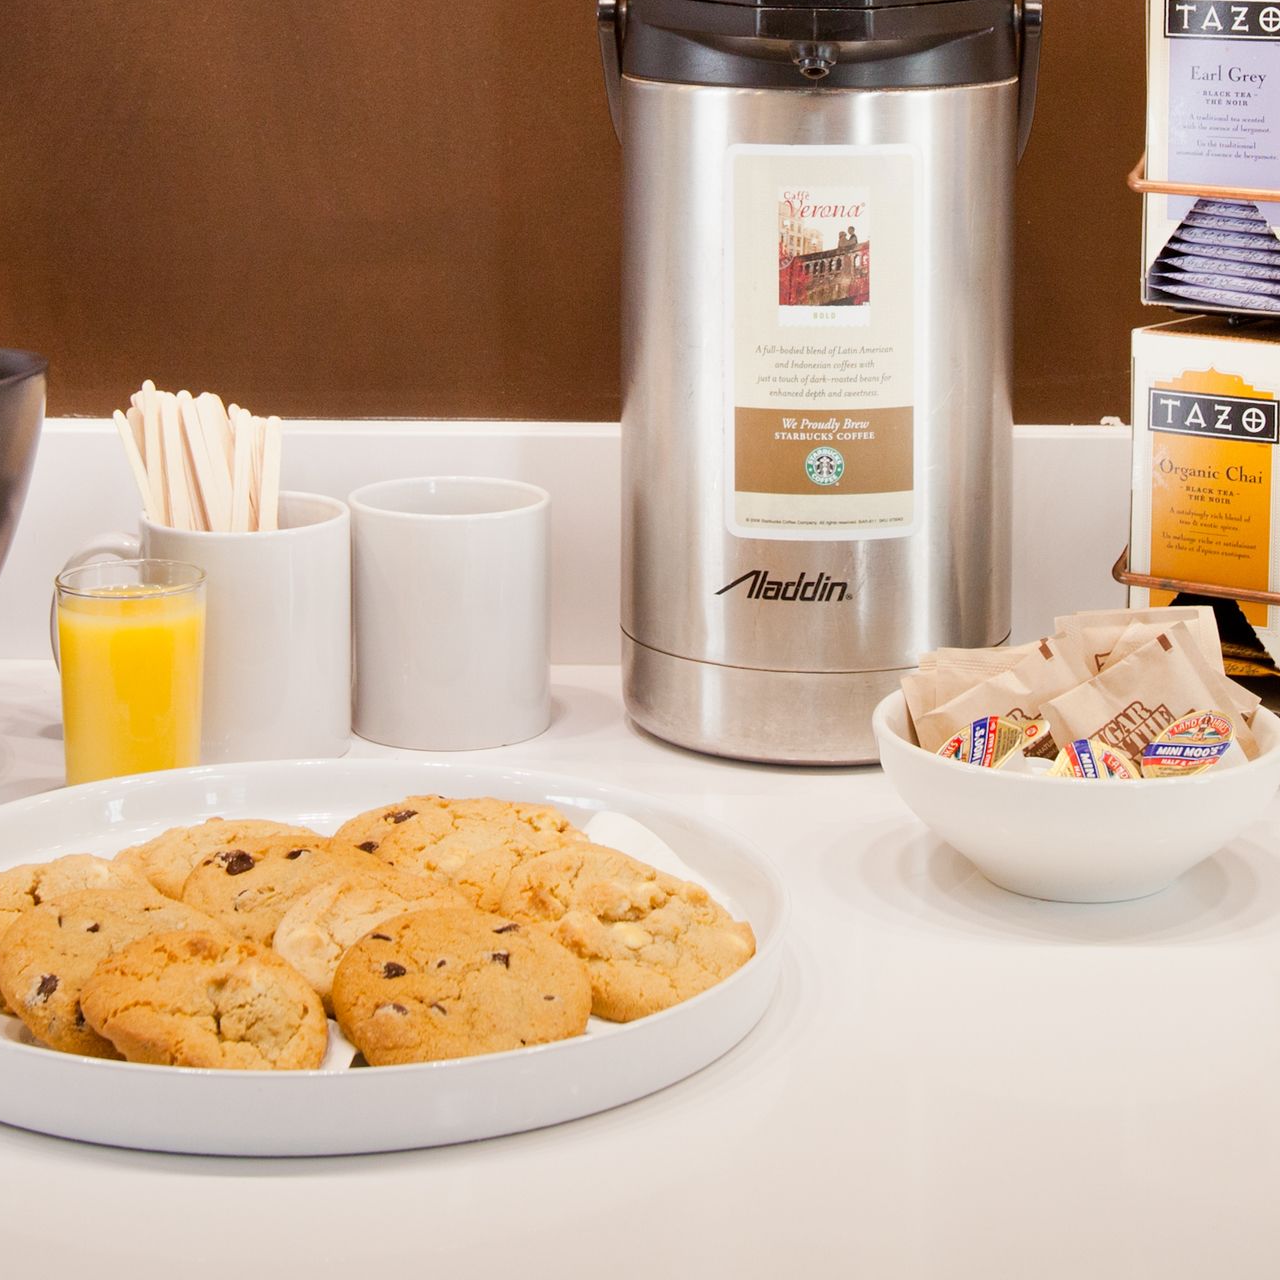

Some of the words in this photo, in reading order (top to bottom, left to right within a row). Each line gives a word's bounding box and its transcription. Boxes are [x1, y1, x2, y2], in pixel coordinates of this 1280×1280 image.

[1190, 65, 1222, 81] Earl
[1228, 67, 1267, 89] Grey
[755, 345, 762, 354] A
[762, 345, 804, 356] full-bodied
[807, 346, 826, 354] blend
[828, 346, 837, 357] of
[838, 346, 858, 354] Latin
[860, 346, 893, 354] American
[775, 360, 788, 368] and
[791, 360, 831, 369] Indonesian
[833, 360, 857, 371] coffees
[757, 375, 770, 384] just
[779, 374, 798, 383] touch
[800, 374, 808, 385] of
[810, 374, 858, 383] dark-roasted
[860, 374, 879, 382] beans
[880, 372, 892, 384] for
[769, 388, 804, 397] enhanced
[805, 389, 825, 400] depth
[828, 388, 841, 397] and
[1160, 398, 1266, 433] TAZO
[782, 418, 796, 429] We
[800, 418, 840, 433] Proudly
[843, 418, 870, 429] Brew
[775, 432, 833, 440] STARBUCKS
[836, 432, 875, 440] COFFEE
[807, 447, 842, 465] STARBUCKS
[1160, 458, 1220, 482] Organic
[1225, 466, 1263, 485] Chai
[811, 473, 837, 485] COFFEE
[1185, 485, 1214, 495] BLACK
[1208, 496, 1232, 504] NOIR
[714, 570, 848, 602] Aladdin
[1174, 719, 1197, 732] LAND
[1156, 747, 1182, 755] MINI
[1184, 746, 1219, 757] MOO'S
